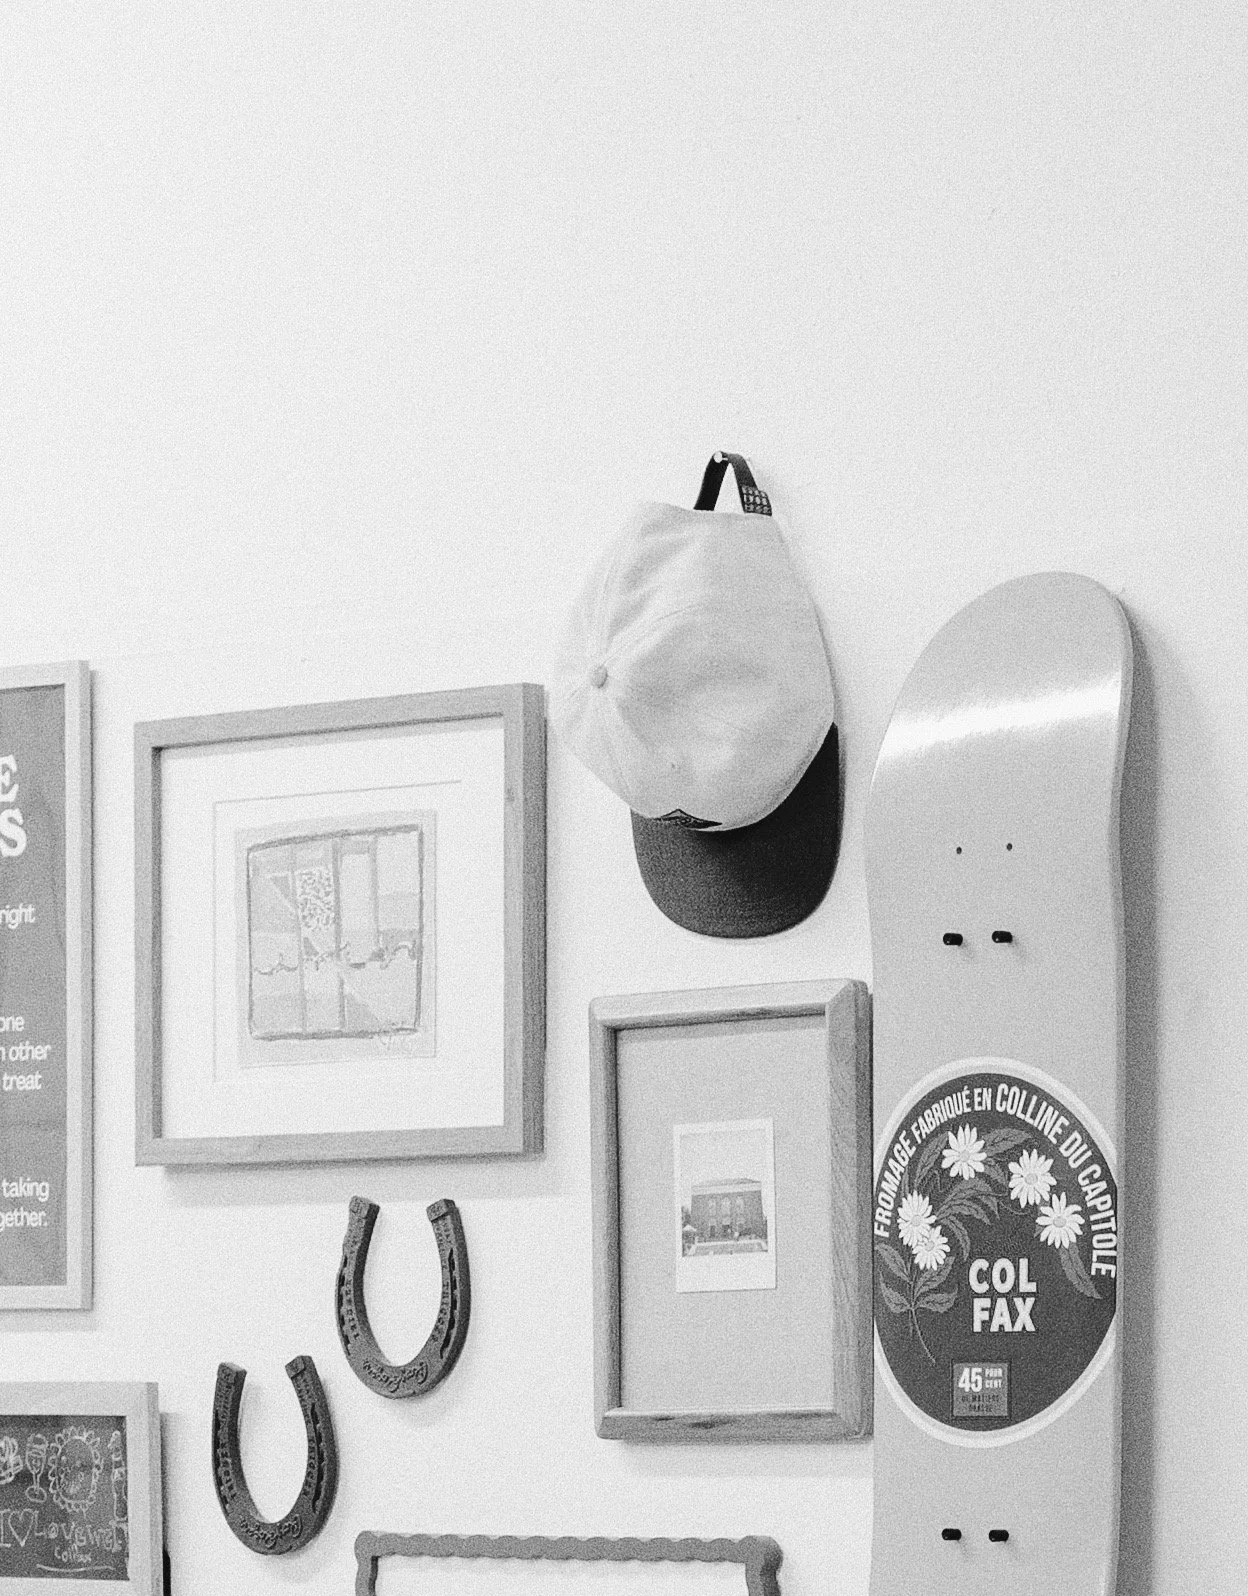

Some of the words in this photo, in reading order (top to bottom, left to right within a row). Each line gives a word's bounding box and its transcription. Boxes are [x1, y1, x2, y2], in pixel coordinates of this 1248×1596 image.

[9, 1040, 51, 1062] other
[2, 1071, 42, 1091] treat
[2, 1177, 50, 1202] taking
[874, 1129, 917, 1238] FROMAGE
[910, 1085, 972, 1145] FABRIQUÉ
[973, 1087, 993, 1112] EN
[995, 1083, 1070, 1144] COLLINE
[1059, 1130, 1093, 1169] DU
[1077, 1163, 1117, 1279] CAPITOLE
[968, 1257, 1037, 1294] COL
[972, 1297, 1037, 1333] FAX
[958, 1367, 983, 1393] 45
